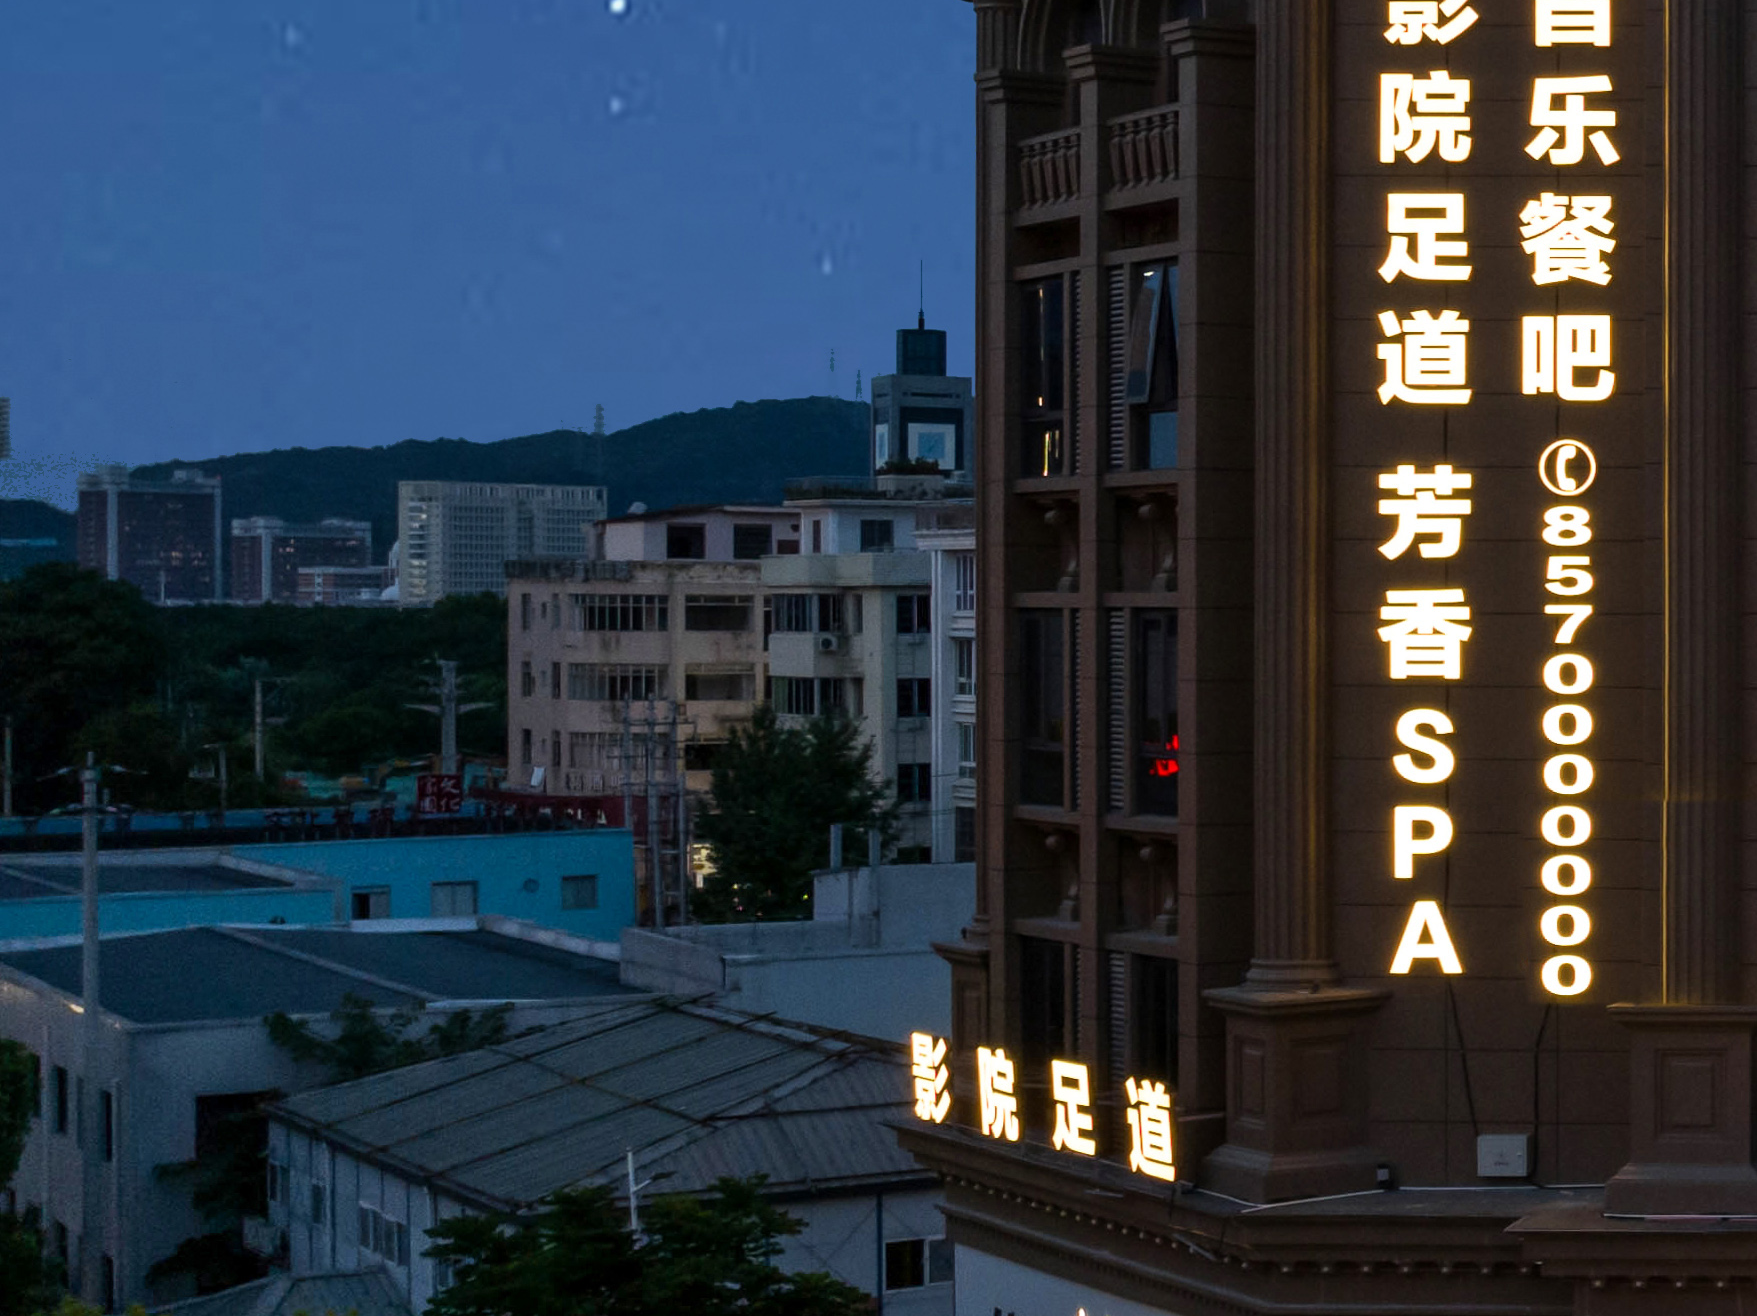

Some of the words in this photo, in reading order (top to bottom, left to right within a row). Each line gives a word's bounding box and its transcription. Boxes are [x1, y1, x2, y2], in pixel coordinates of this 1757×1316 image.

[1377, 464, 1473, 975] 芳香SPA
[910, 1031, 1176, 1182] 影院足道
